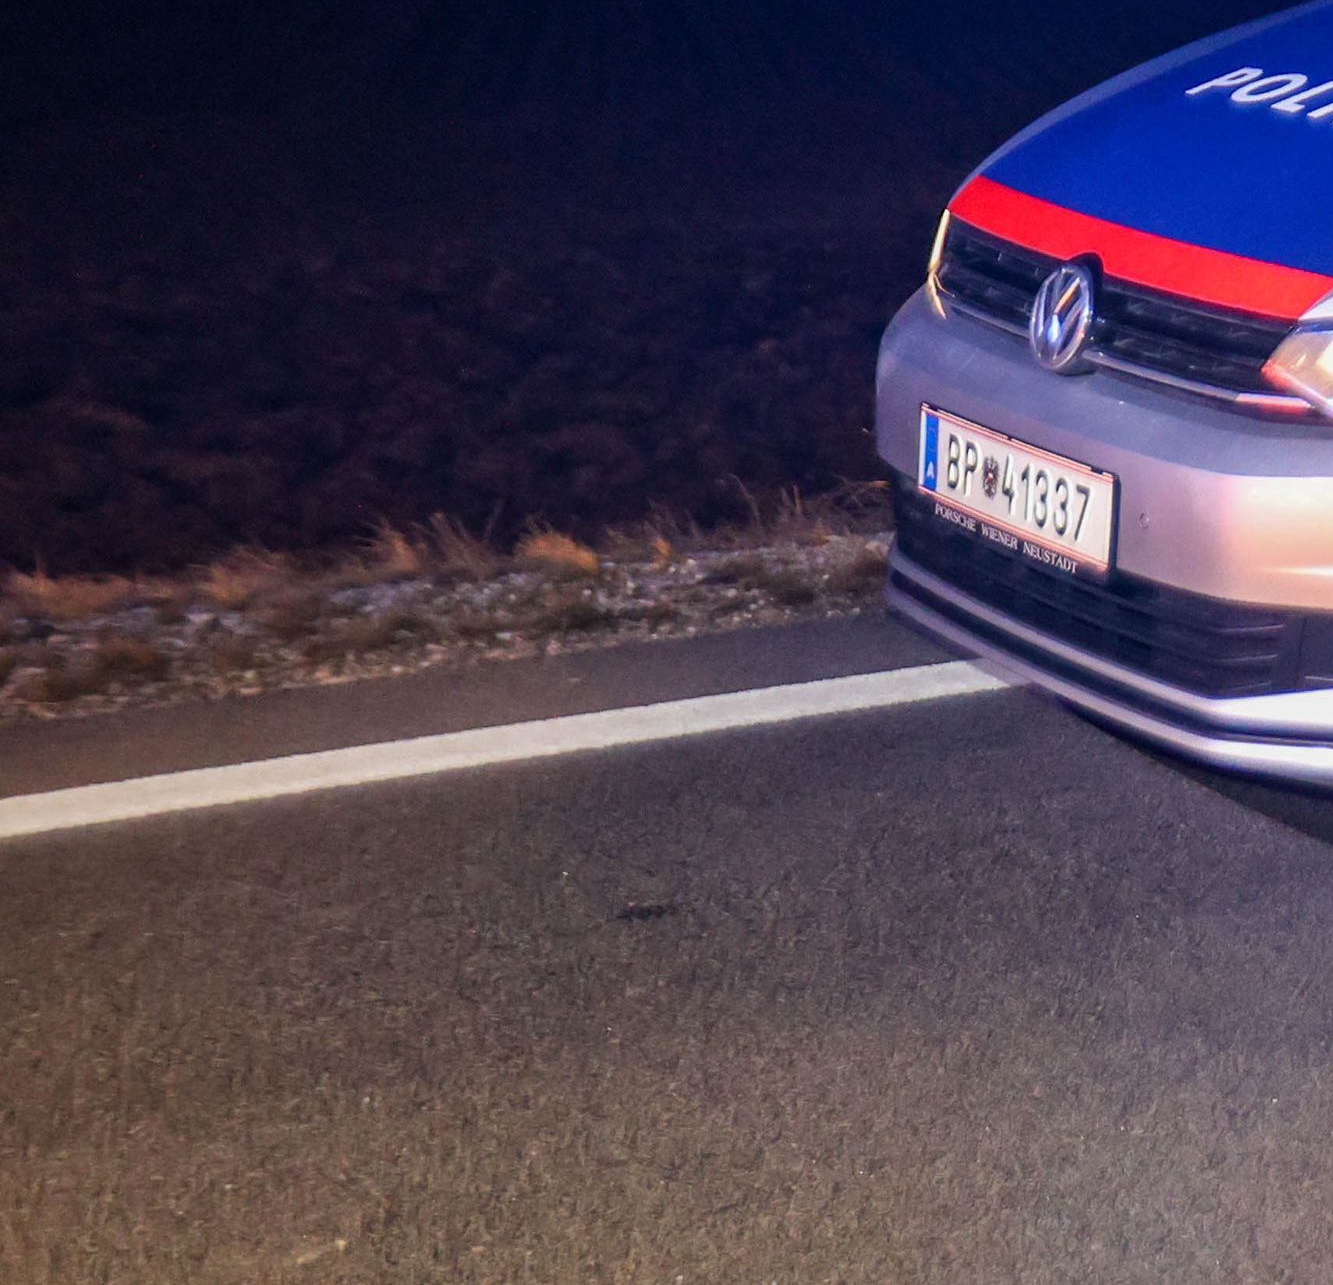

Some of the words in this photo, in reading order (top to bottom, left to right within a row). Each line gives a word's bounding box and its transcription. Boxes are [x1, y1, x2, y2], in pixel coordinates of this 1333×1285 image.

[926, 460, 934, 478] A
[947, 433, 981, 496] BP
[1002, 453, 1093, 542] 41337
[935, 503, 976, 532] PORSCHE
[981, 523, 1018, 550] WIENER
[1023, 542, 1078, 574] NEUSTADT
